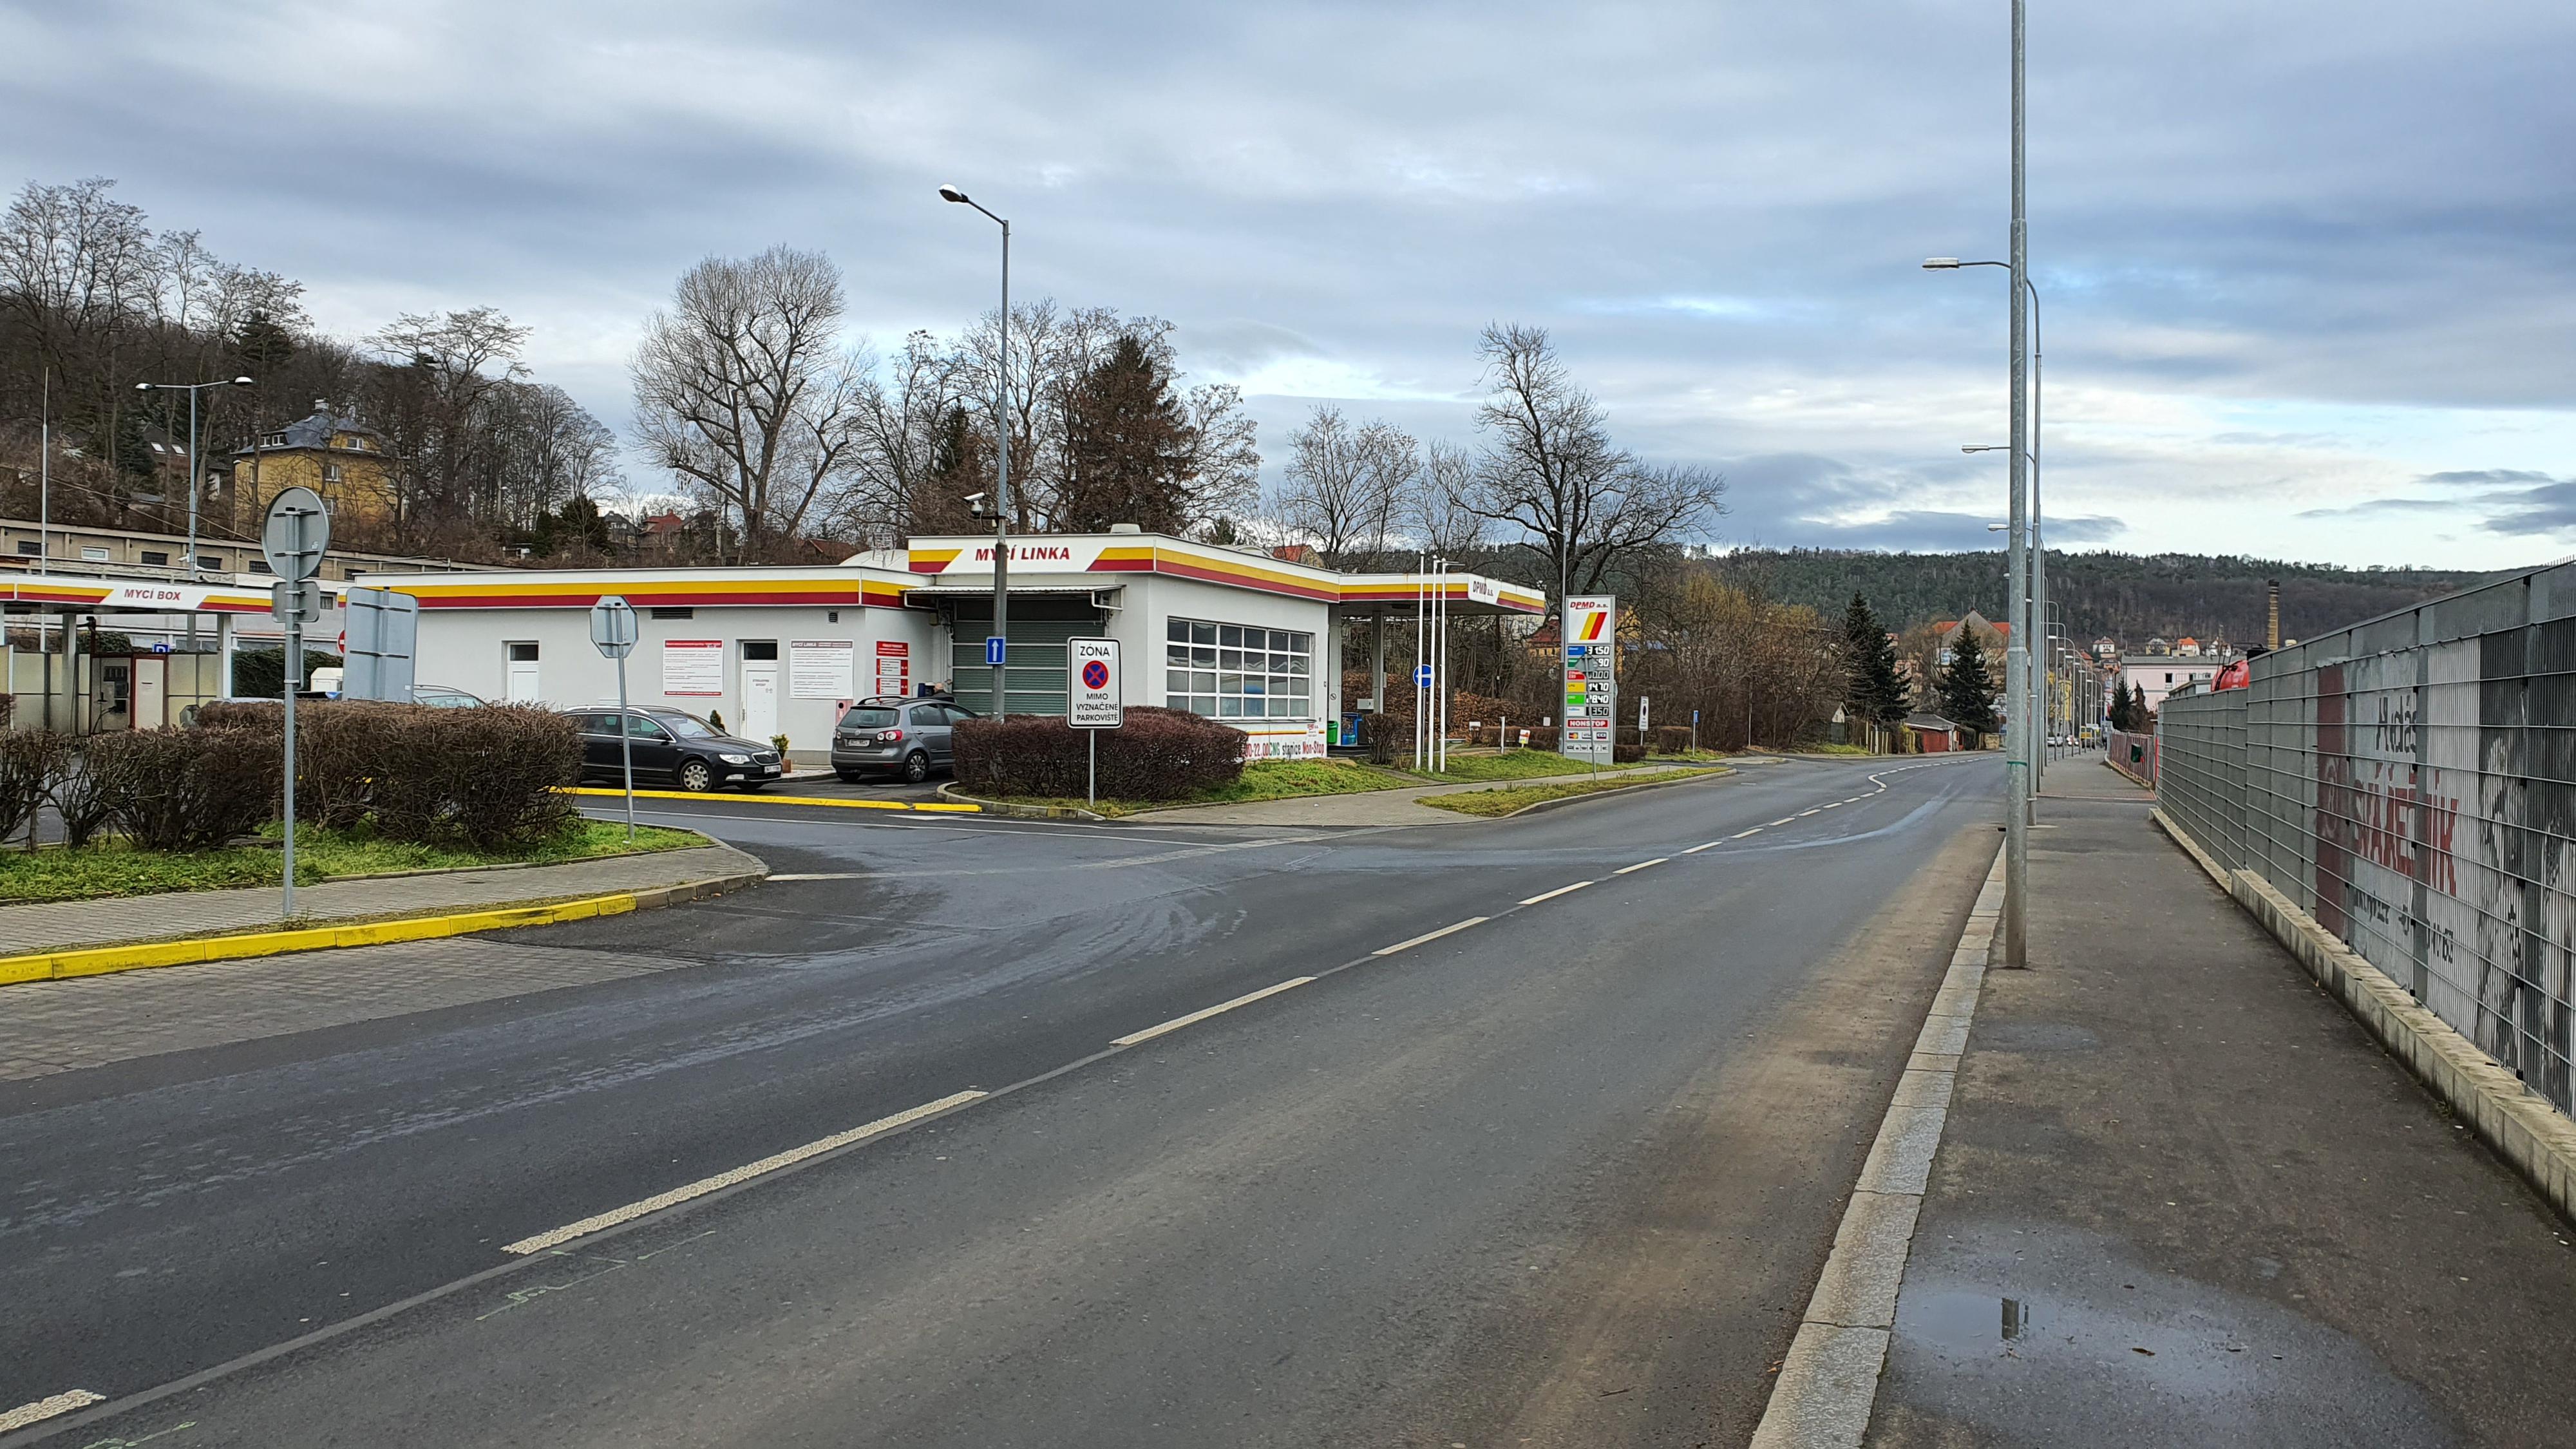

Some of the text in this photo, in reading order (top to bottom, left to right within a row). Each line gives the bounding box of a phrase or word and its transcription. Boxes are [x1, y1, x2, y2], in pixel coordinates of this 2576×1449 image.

[975, 544, 1070, 561] MYÍ LINKA
[1473, 580, 1487, 595] DPMD
[124, 588, 182, 600] MYCÍ BOX
[1570, 601, 1595, 610] DPMD
[1080, 643, 1110, 656] ZÓNA
[1076, 702, 1118, 710] VYZNAČENÉ
[1077, 712, 1118, 721] PARKOVIŠTĚ
